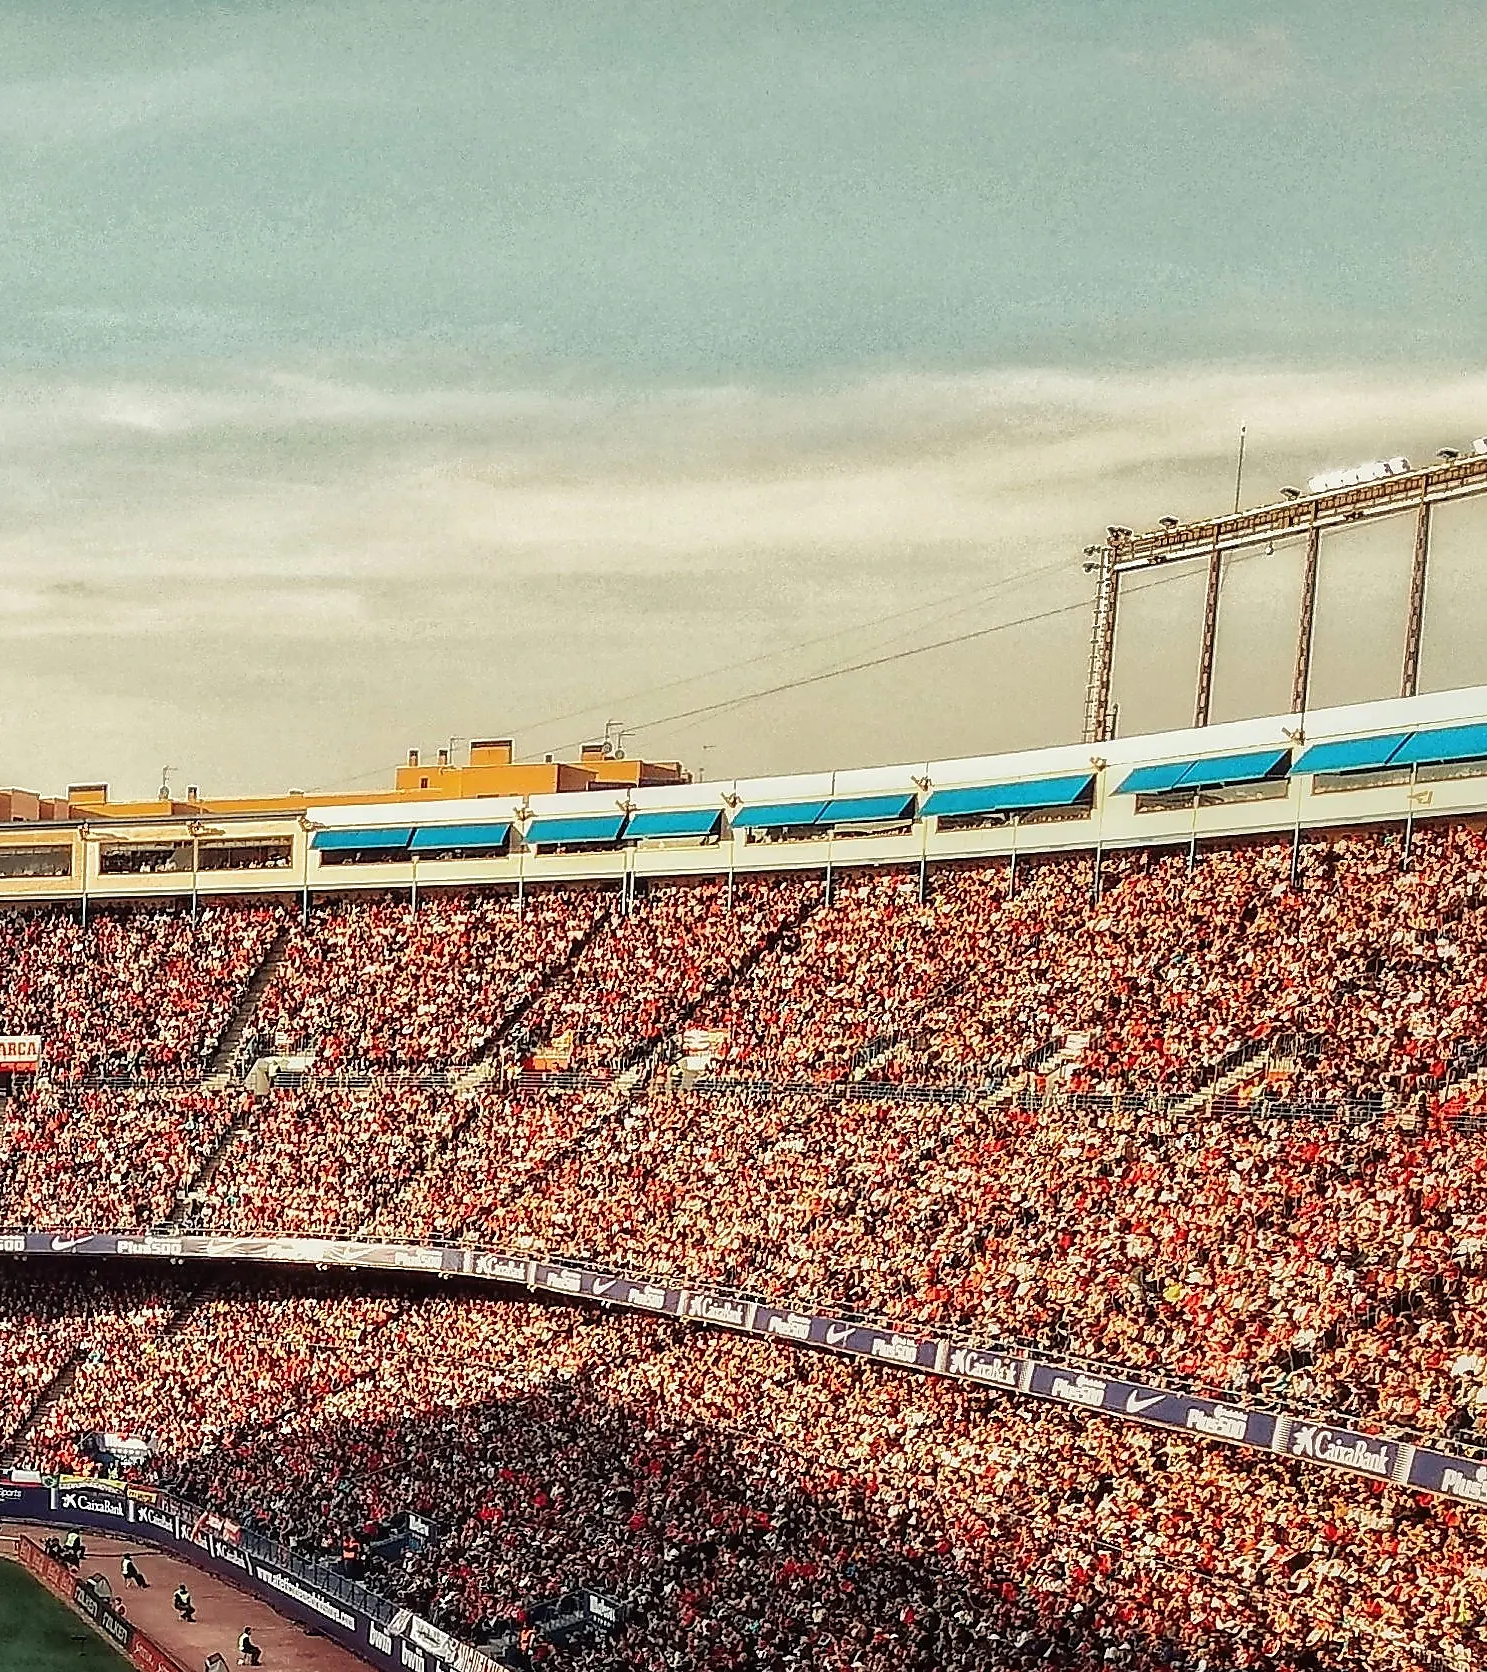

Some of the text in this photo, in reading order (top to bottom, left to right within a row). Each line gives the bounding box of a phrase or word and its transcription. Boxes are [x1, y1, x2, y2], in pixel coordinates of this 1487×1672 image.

[117, 1239, 182, 1256] Plus500
[1186, 1409, 1246, 1440] Plus500
[1314, 1431, 1389, 1474] CaixaBank
[78, 1496, 124, 1517] CaixaBank
